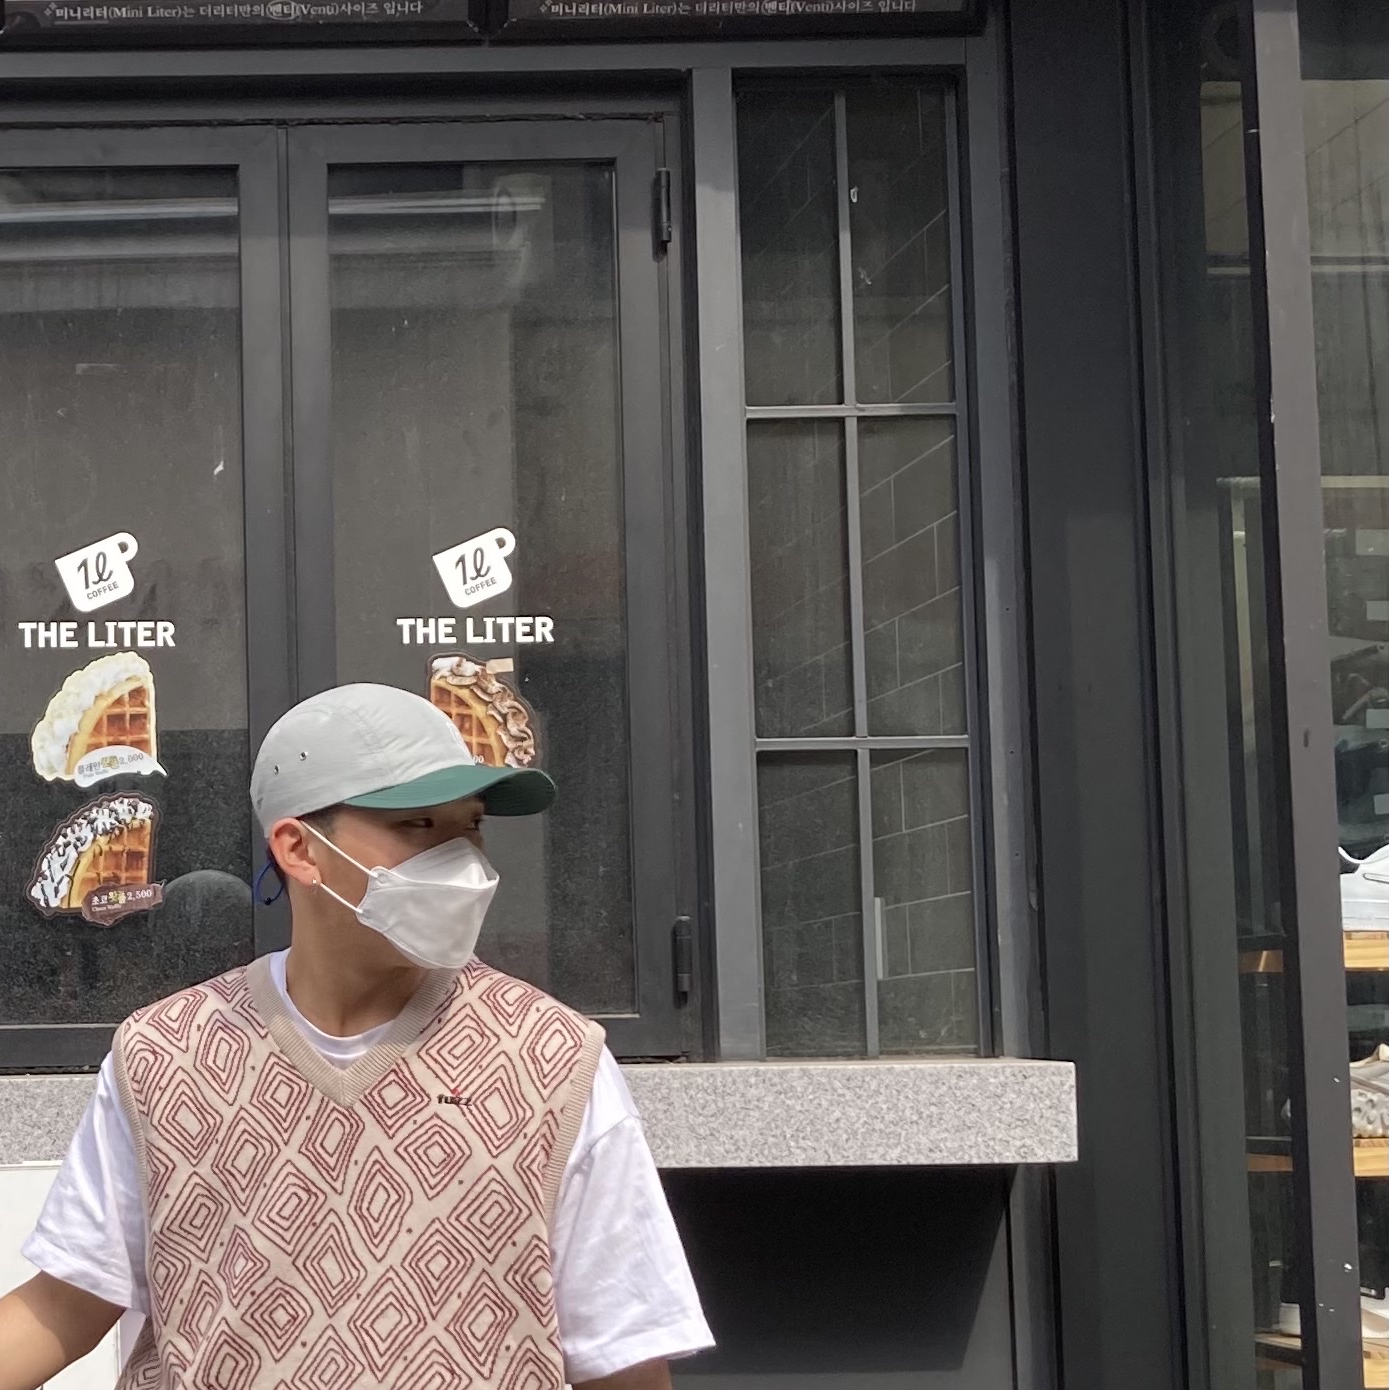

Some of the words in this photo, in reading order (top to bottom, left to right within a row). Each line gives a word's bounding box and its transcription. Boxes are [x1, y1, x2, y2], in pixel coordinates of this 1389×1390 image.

[87, 581, 120, 600] COFFEE
[464, 577, 498, 596] COFFEE
[18, 621, 79, 648] THE
[88, 621, 176, 647] LITER
[396, 617, 457, 644] THE
[466, 616, 555, 643] LITER
[127, 889, 152, 901] 2,500
